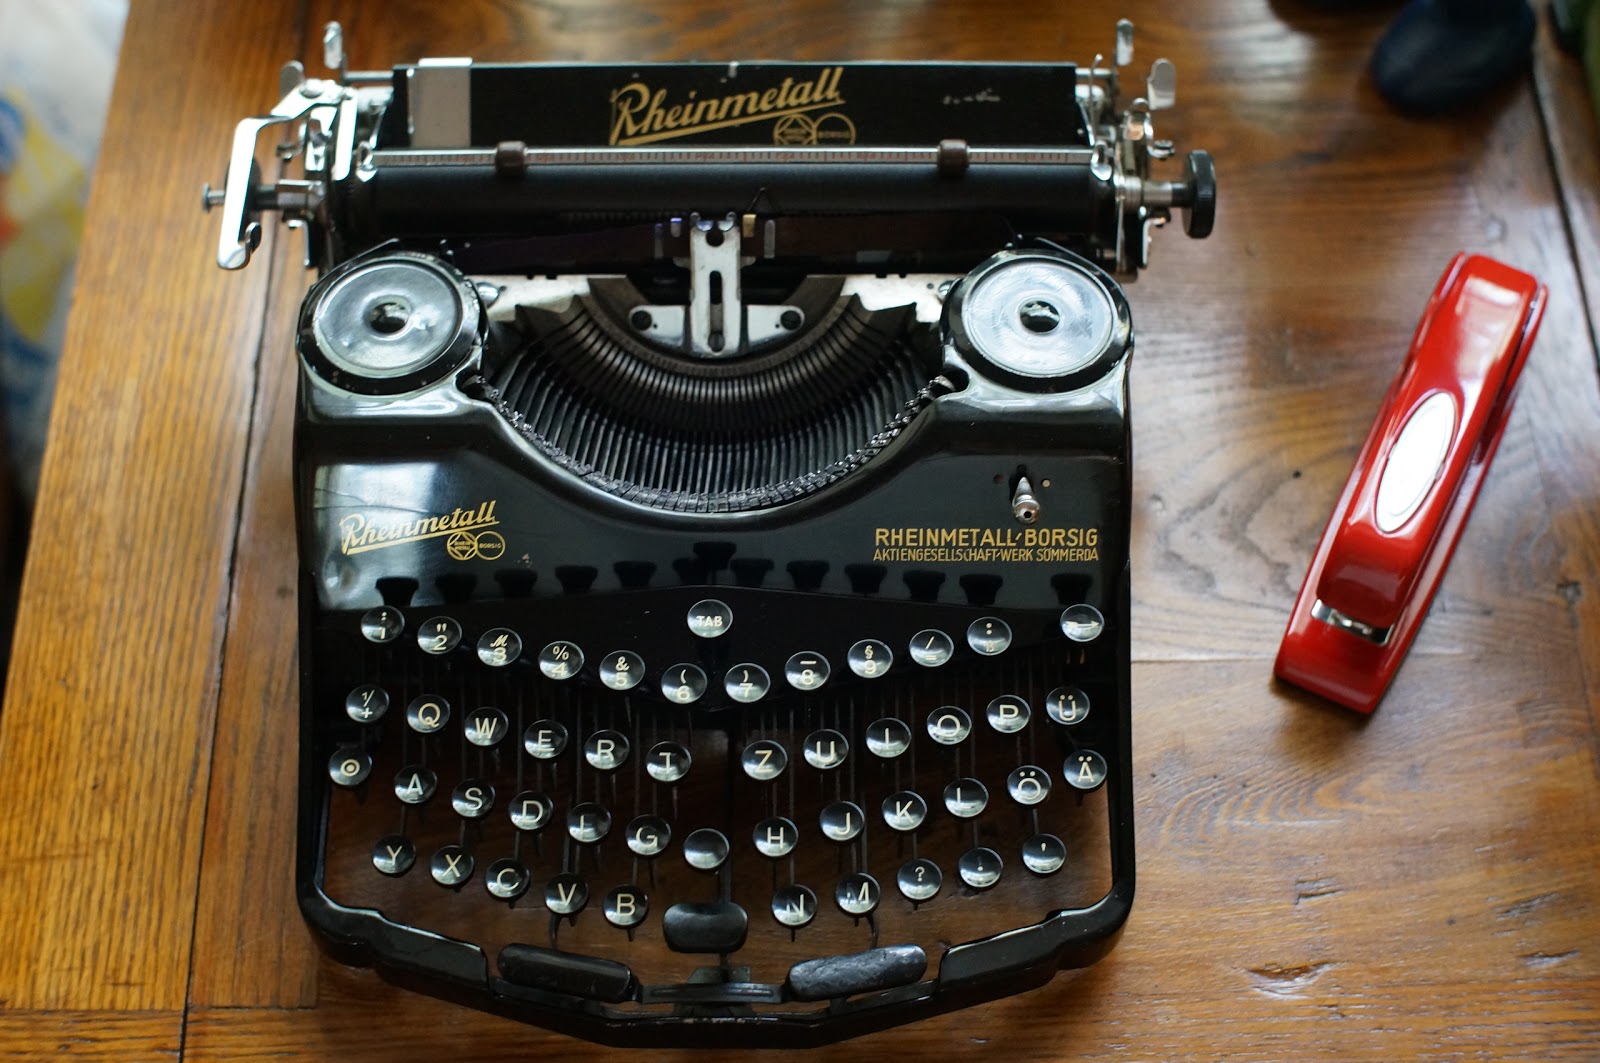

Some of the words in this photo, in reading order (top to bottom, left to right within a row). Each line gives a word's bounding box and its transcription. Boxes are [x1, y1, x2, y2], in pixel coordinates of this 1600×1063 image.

[610, 66, 845, 145] Rheinmetall
[339, 500, 499, 555] Rheinmetall
[696, 615, 723, 627] TAB
[434, 634, 448, 650] 2
[801, 669, 814, 685] 8
[864, 660, 877, 675] 9
[615, 672, 628, 687] 5
[676, 685, 690, 701] 6
[418, 703, 441, 728] Q
[1000, 704, 1019, 726] P
[1058, 694, 1076, 721] Ü
[475, 717, 498, 739] W
[937, 714, 961, 737] O
[537, 730, 555, 752] E
[597, 739, 615, 761] R
[816, 741, 836, 763] U
[755, 750, 773, 773] Z
[1077, 755, 1095, 783] Ä
[407, 773, 424, 795] A
[1018, 771, 1041, 800] Ö
[465, 787, 483, 811] S
[522, 800, 544, 823] D
[895, 800, 915, 824] K
[835, 812, 851, 835] J
[636, 826, 658, 847] G
[767, 826, 784, 848] H
[386, 845, 403, 866] Y
[441, 854, 463, 877] X
[496, 868, 520, 891] C
[557, 882, 577, 905] V
[616, 893, 636, 917] B
